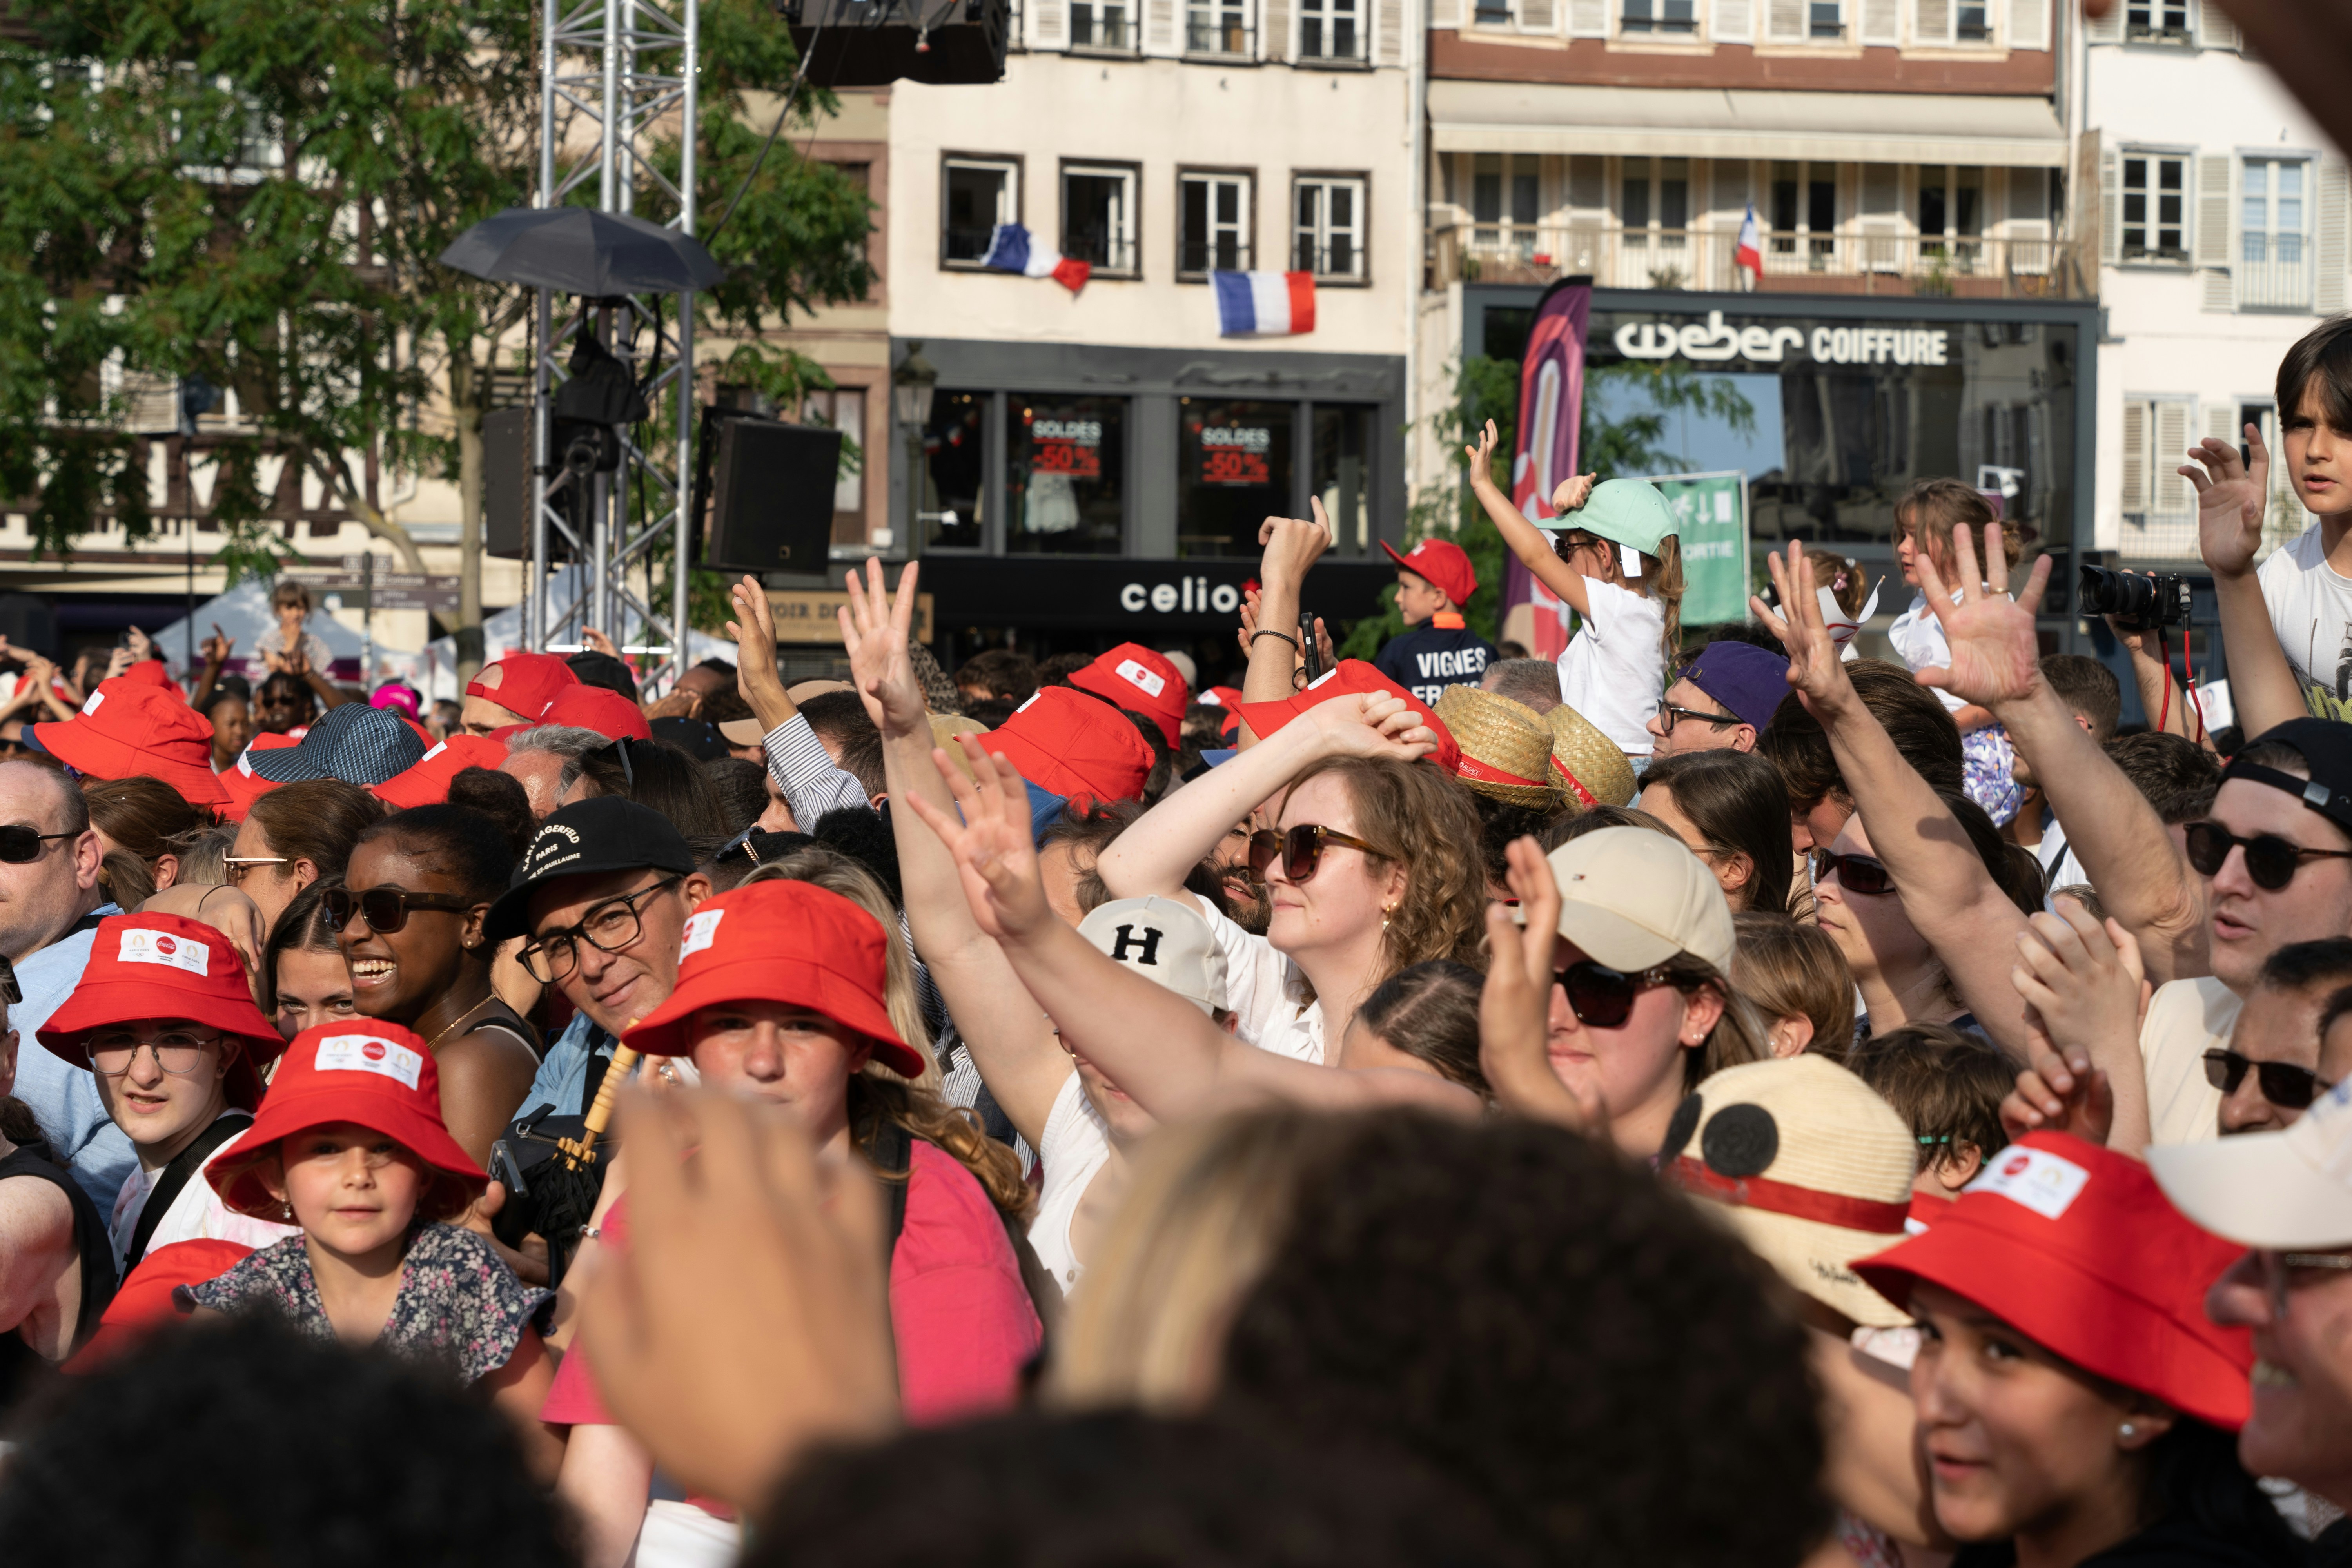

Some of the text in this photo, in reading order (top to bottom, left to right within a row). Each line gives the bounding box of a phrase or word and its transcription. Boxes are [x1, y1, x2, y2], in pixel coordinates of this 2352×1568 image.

[1614, 310, 1948, 365] weber COIFFURE
[1032, 420, 1102, 439] SOLDES
[1201, 427, 1270, 446] SOLDES
[1033, 445, 1100, 470] -50%
[1202, 452, 1269, 477] -50%
[1681, 540, 1734, 561] ORTIE
[1121, 576, 1239, 613] celio
[1416, 647, 1486, 679] VIGNES
[1462, 764, 1480, 775] ALSACE
[522, 825, 580, 872] KARL LAGERFELD
[536, 844, 558, 861] PARIS
[537, 853, 581, 875] ST-GUILLAUME
[1110, 924, 1163, 965] H
